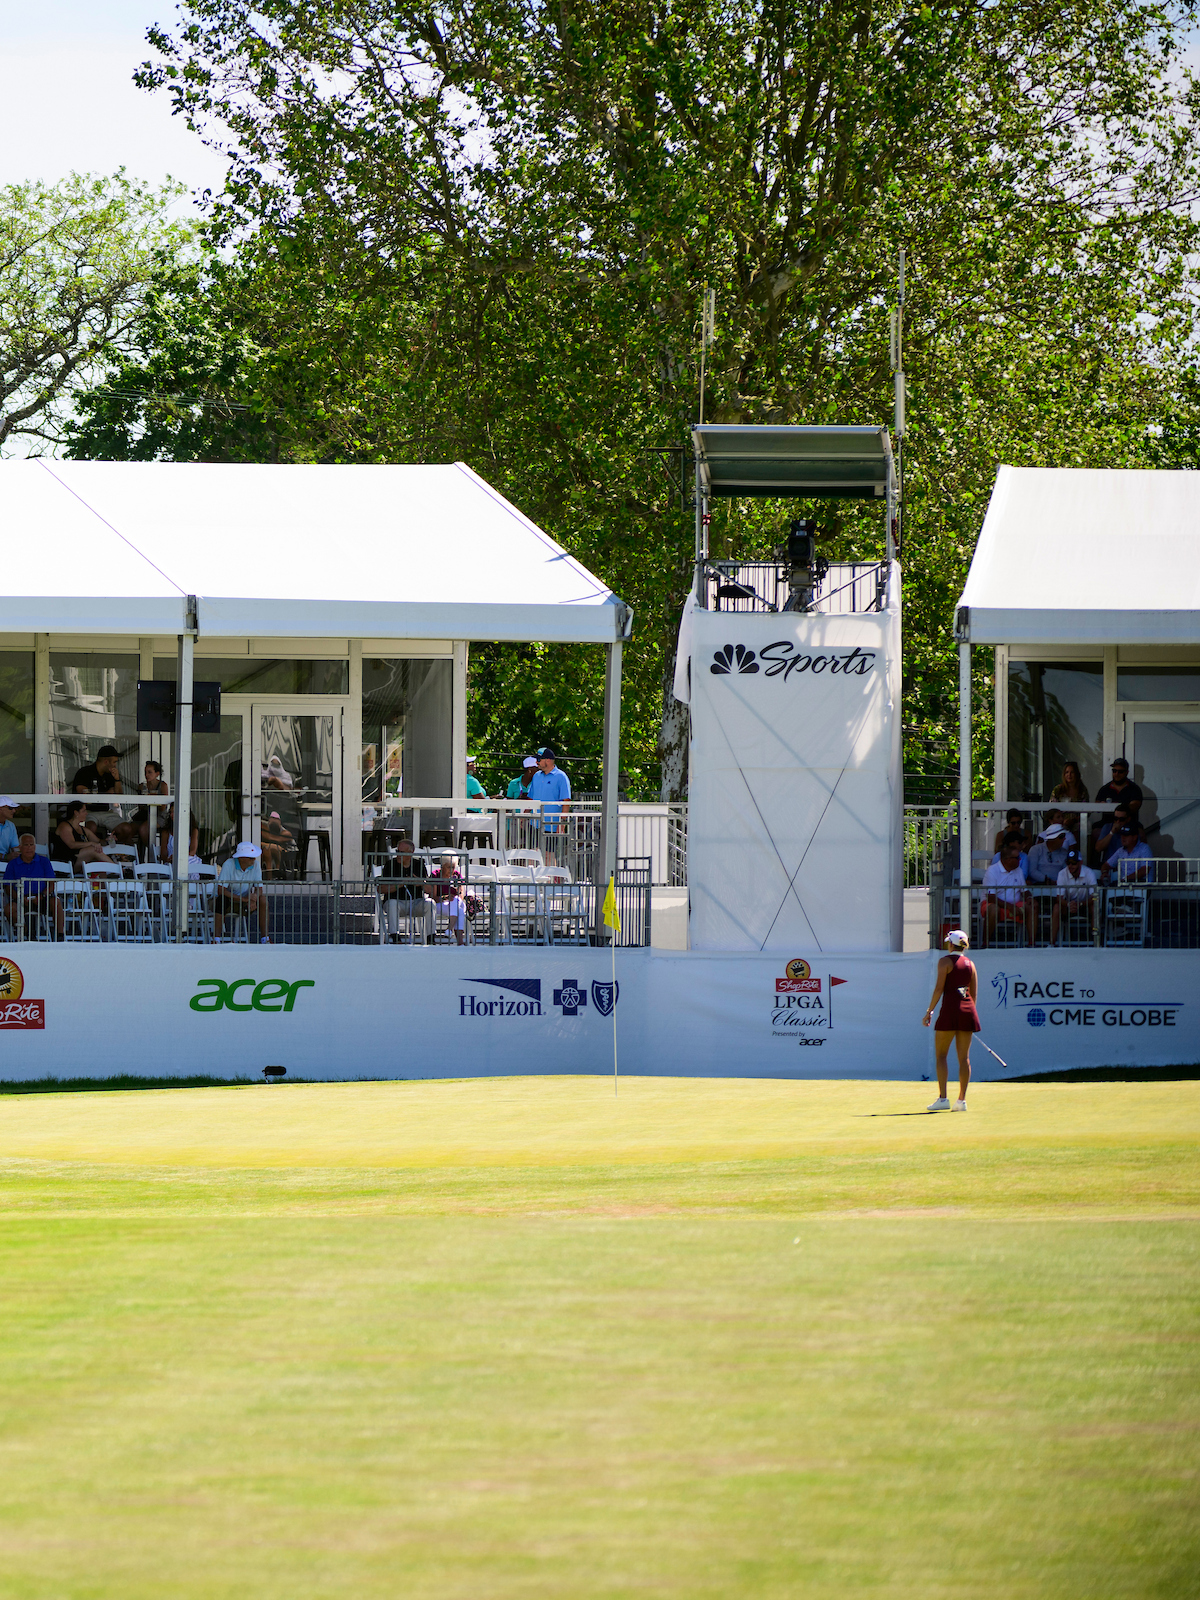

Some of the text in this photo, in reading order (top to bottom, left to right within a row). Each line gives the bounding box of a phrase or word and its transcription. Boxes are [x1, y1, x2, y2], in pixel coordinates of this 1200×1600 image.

[759, 641, 876, 683] Sports
[778, 980, 819, 992] ShopRite
[1014, 982, 1095, 998] RACE TO
[189, 979, 315, 1012] acer
[773, 995, 824, 1009] LPGA
[458, 994, 543, 1016] Horizon
[770, 1009, 827, 1026] Classic
[1049, 1009, 1176, 1027] CME GLOBE
[799, 1038, 827, 1046] acer
